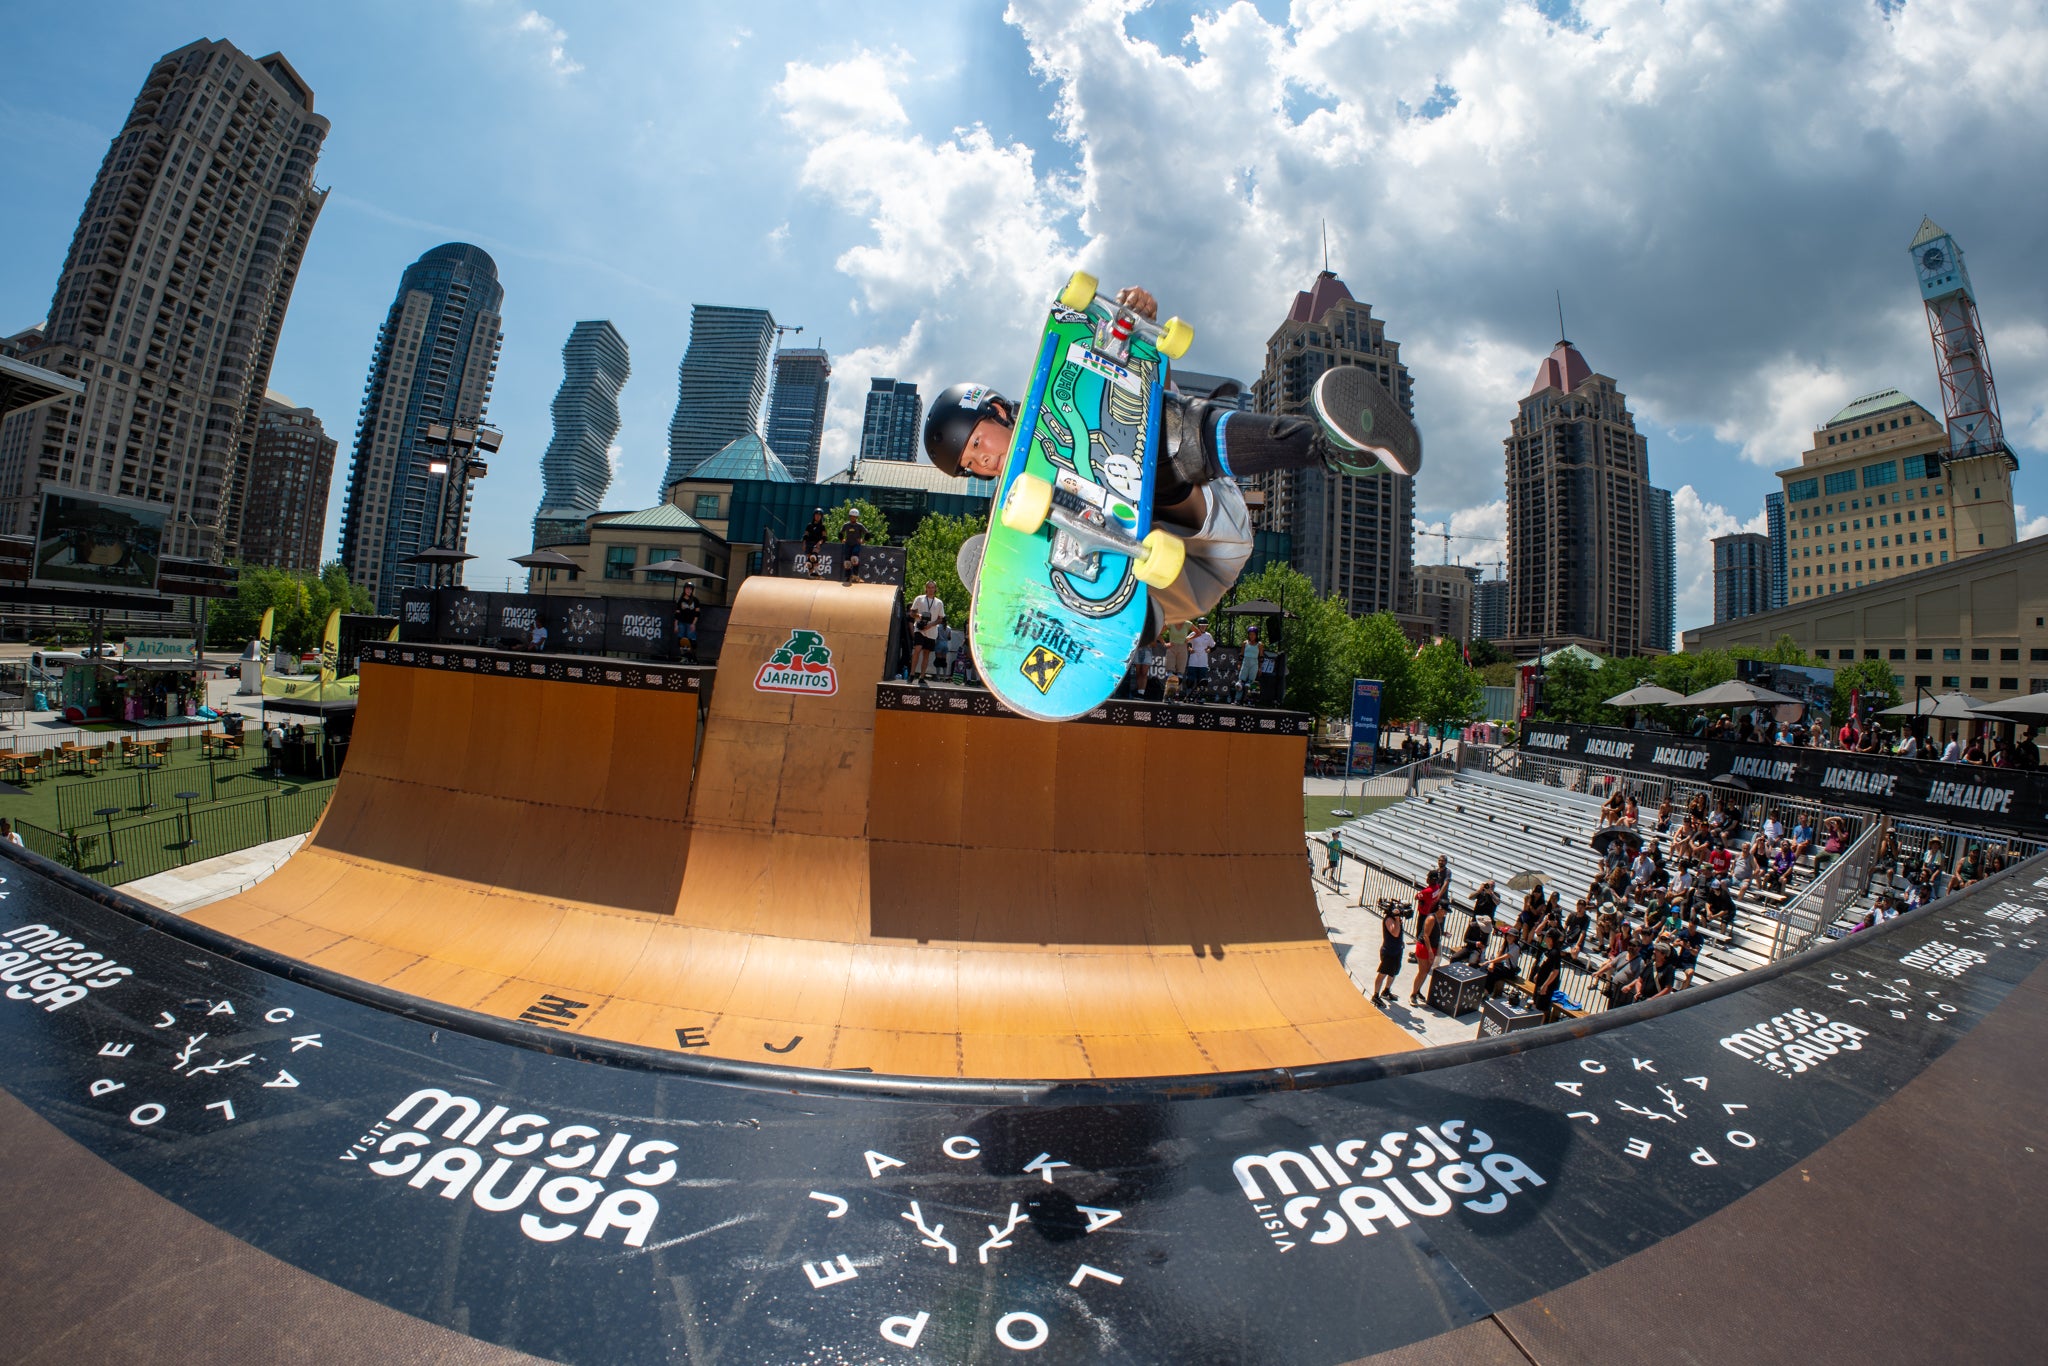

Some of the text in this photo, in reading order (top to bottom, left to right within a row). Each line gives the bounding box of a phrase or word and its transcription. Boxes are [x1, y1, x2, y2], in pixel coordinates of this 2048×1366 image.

[622, 614, 662, 628] MISSIS
[625, 625, 662, 640] SAUGA
[762, 671, 829, 688] JARRITOS
[1527, 731, 1570, 751] JACKALOPE
[1584, 738, 1635, 760] JACKALOPE
[1651, 746, 1710, 770] JACKALOPE
[1730, 756, 1797, 783] JACKALOPE
[1820, 767, 1898, 797] JACKALOPE
[1925, 780, 2015, 814] JACKALOPE
[2, 924, 134, 988] MISSIS
[1719, 1007, 1829, 1060] MISSIS
[1766, 1021, 1870, 1073] SAUGA
[1753, 1058, 1792, 1079] VISIT
[339, 1120, 392, 1162] VISIT
[386, 1088, 679, 1186] MISSIS
[1232, 1119, 1494, 1200] MISSIS
[368, 1131, 660, 1247] SAUGA
[1283, 1153, 1548, 1245] SAUGA
[1253, 1203, 1297, 1253] VISIT
